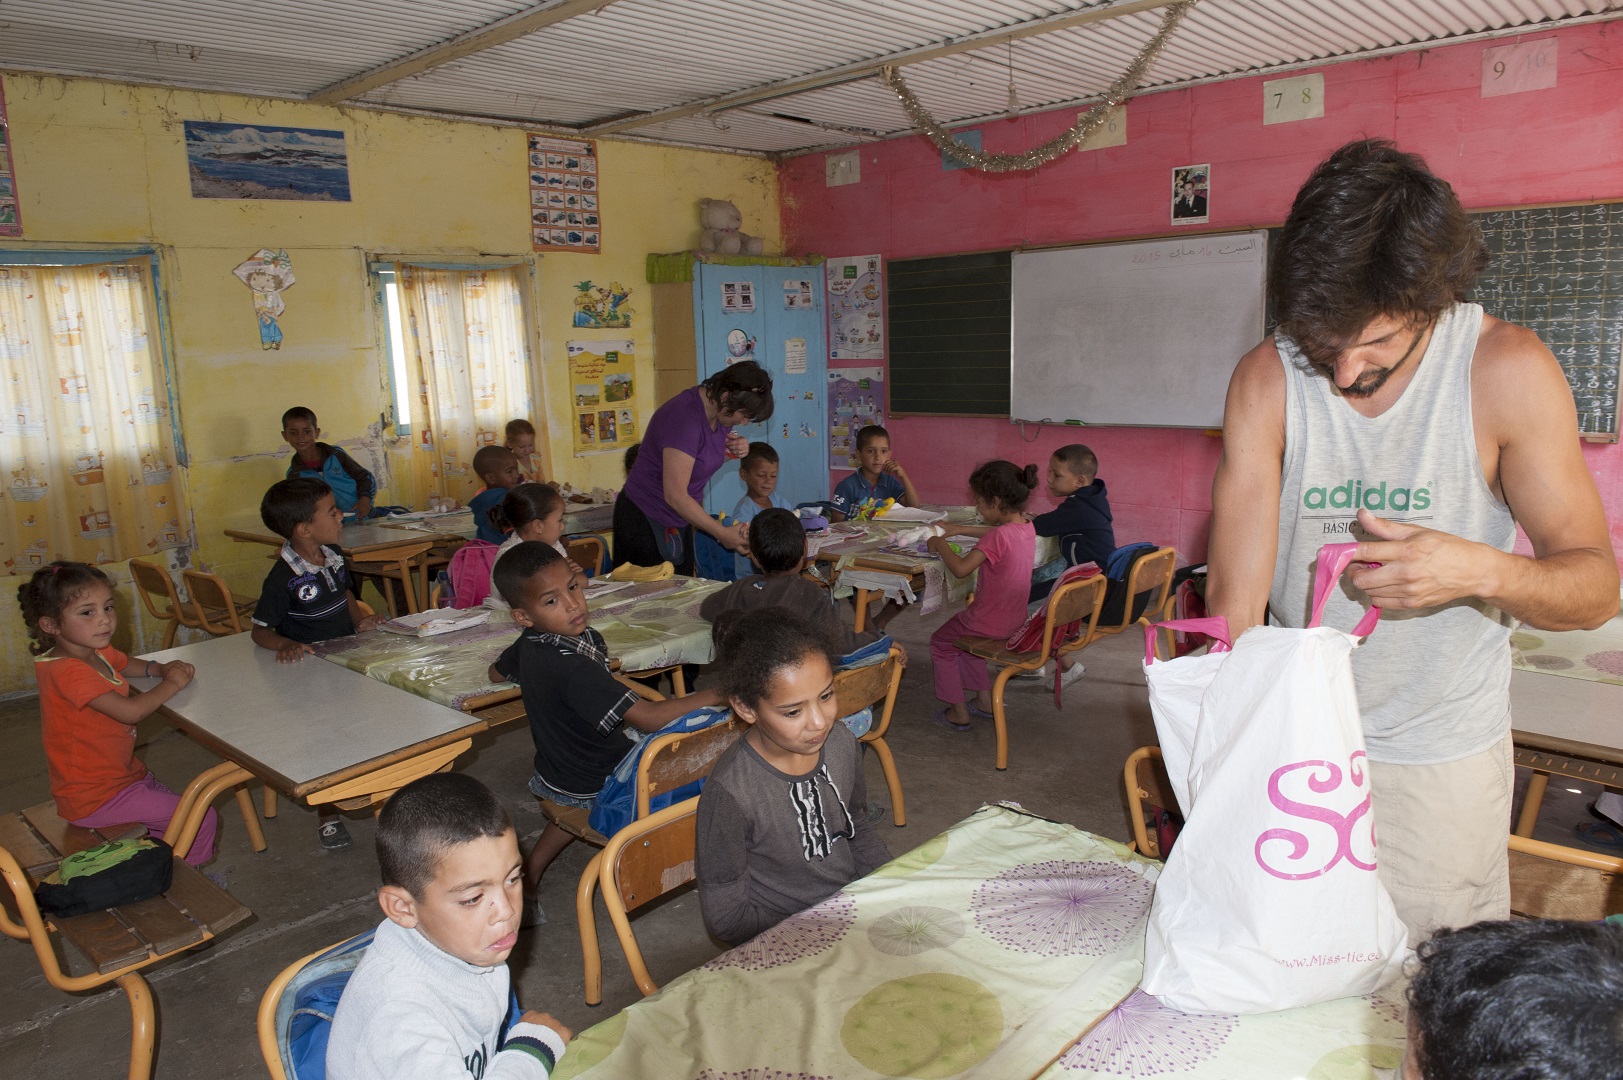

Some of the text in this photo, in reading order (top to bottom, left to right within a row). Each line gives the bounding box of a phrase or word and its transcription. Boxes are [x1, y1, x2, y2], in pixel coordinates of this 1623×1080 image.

[1493, 51, 1546, 80] 9 10
[1273, 87, 1312, 109] 7 8
[1108, 117, 1117, 133] 6
[1303, 479, 1431, 511] adidas
[1322, 522, 1356, 533] BASIC
